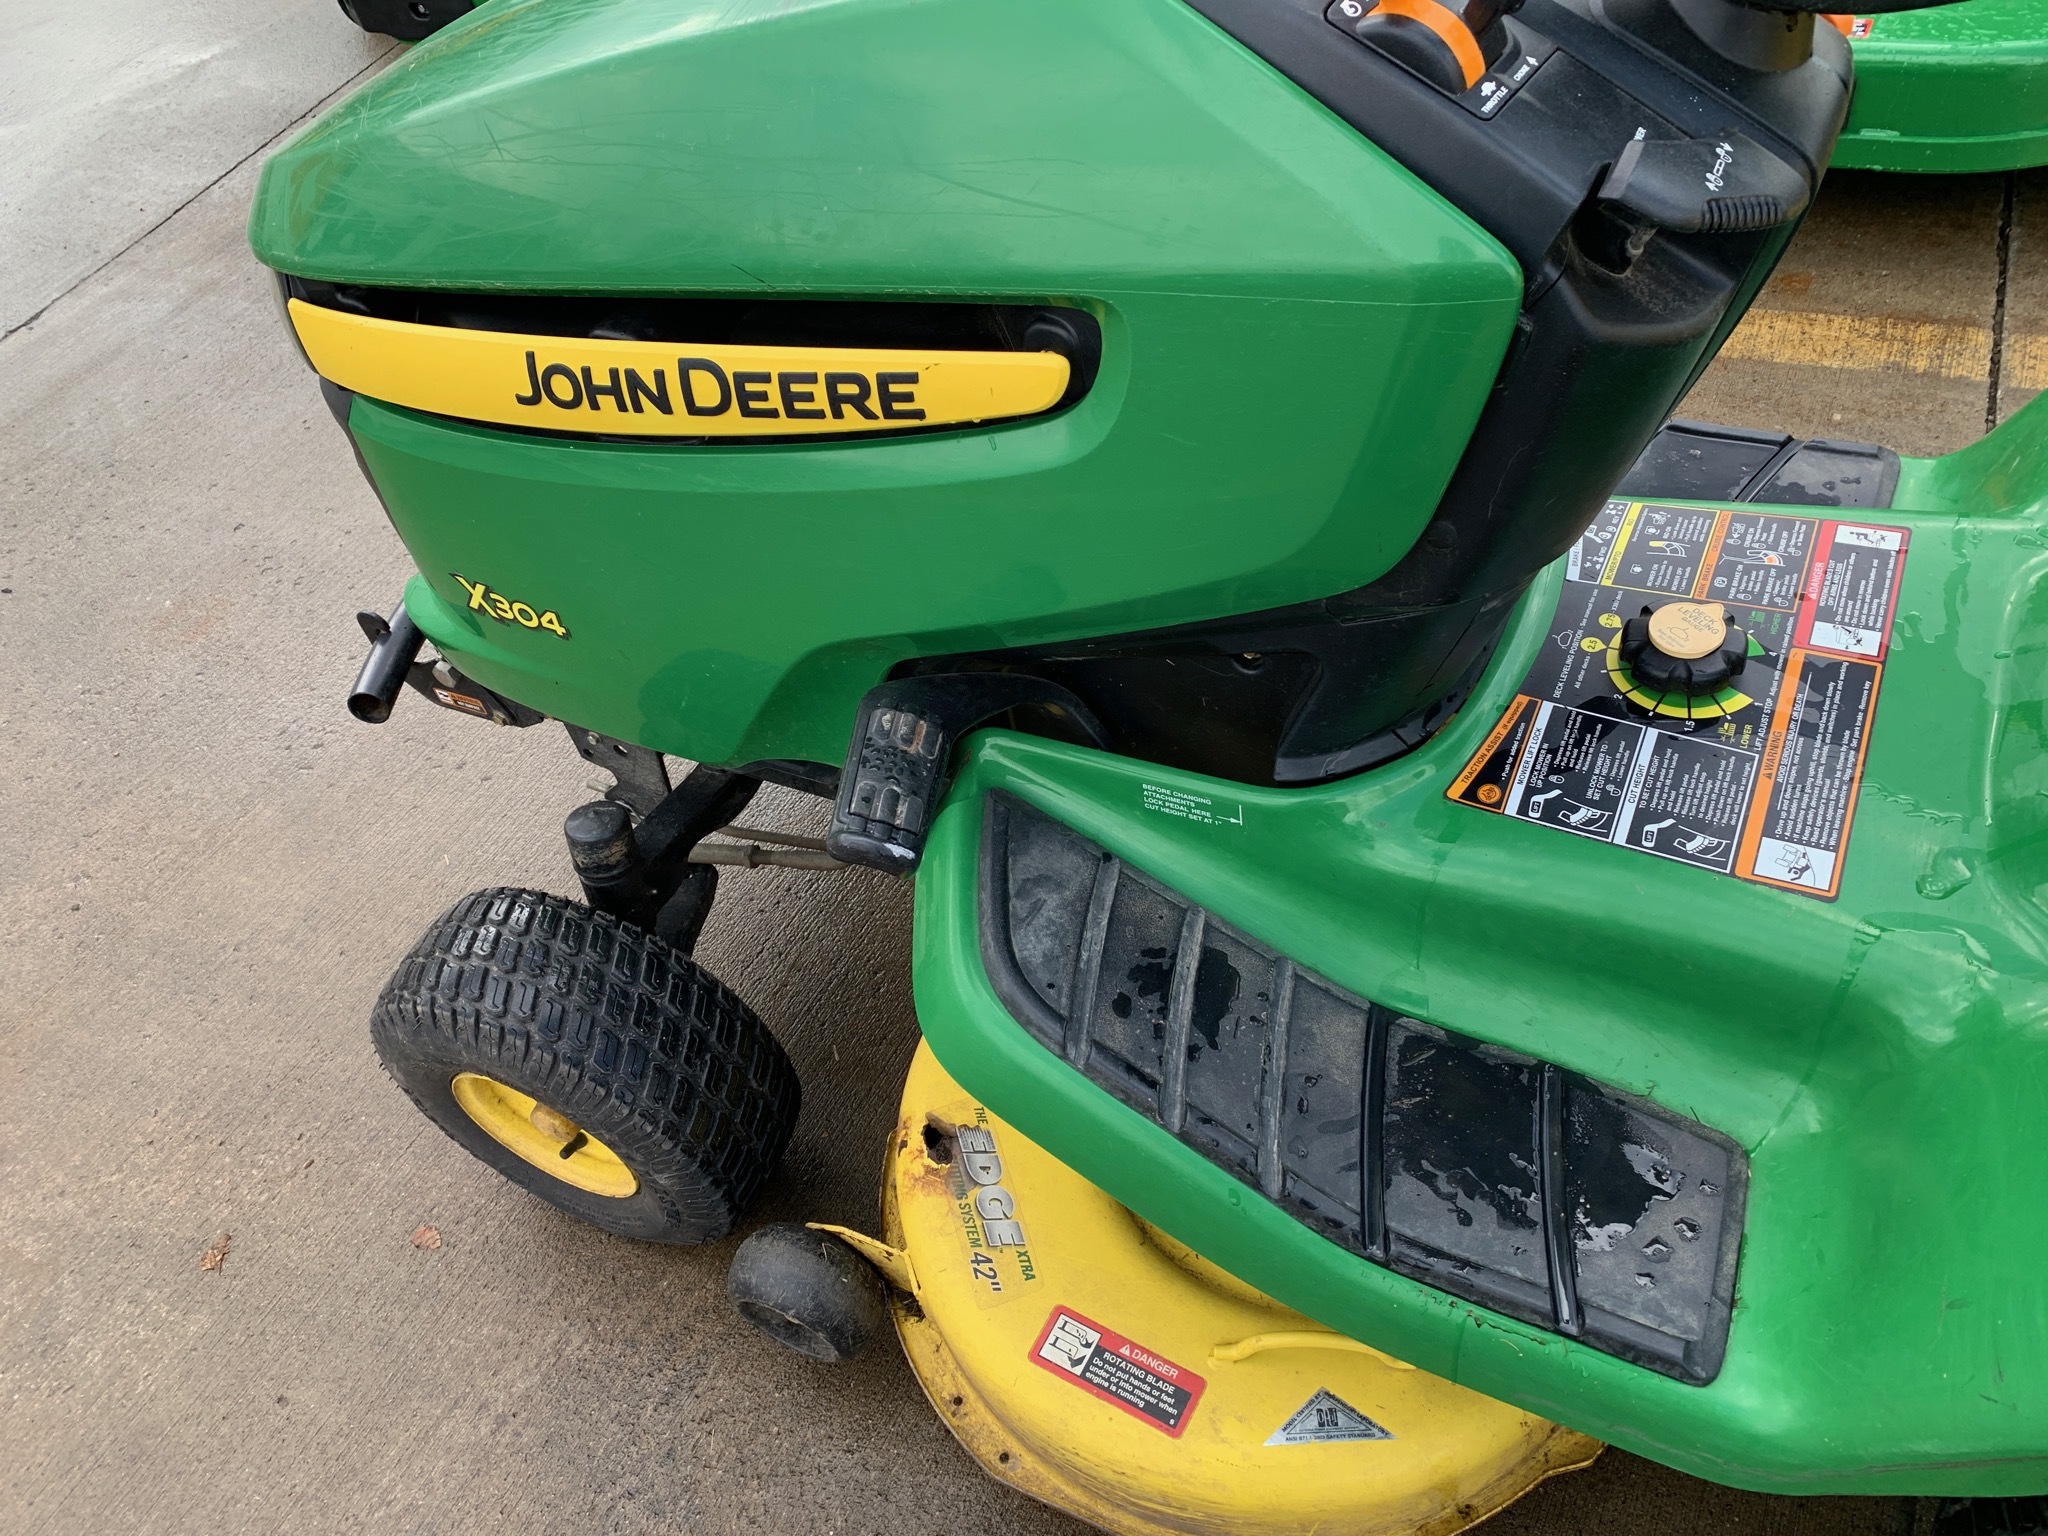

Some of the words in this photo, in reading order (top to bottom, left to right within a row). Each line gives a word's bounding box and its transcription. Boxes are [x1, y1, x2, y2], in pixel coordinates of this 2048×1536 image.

[1513, 64, 1531, 82] CHOKE
[1481, 85, 1509, 114] THROTTLE
[515, 350, 673, 415] JOHN
[677, 357, 926, 421] DEERE
[1711, 535, 1722, 552] CRUISE
[1717, 514, 1730, 534] CONTROL
[1696, 584, 1706, 598] PARK
[1702, 563, 1713, 581] BRAKE
[1809, 562, 1825, 592] DANGER
[449, 574, 570, 638] X304
[1692, 607, 1717, 625] DECK
[1605, 614, 1616, 627] 2.75
[1678, 606, 1720, 635] LEVELING
[1681, 616, 1704, 632] GAUGE
[1770, 613, 1782, 635] HIGHER
[1553, 682, 1565, 698] DECK
[1559, 654, 1575, 681] LEVELING
[1569, 630, 1585, 654] POSITION
[1583, 603, 1593, 618] manual
[1588, 640, 1598, 650] 2.5
[1581, 656, 1591, 669] decks
[1577, 670, 1586, 681] other
[1764, 698, 1773, 713] STOP
[1794, 693, 1804, 711] DEATH
[1684, 720, 1695, 732] 1.5
[1757, 714, 1769, 737] ADJUST
[1792, 711, 1800, 720] OR
[1739, 724, 1753, 749] LOWER
[1787, 720, 1797, 740] INJURY
[1461, 753, 1488, 783] TRACTION
[1483, 731, 1504, 753] ASSIST
[1505, 701, 1525, 724] equipped)
[1501, 764, 1511, 777] Push
[1509, 741, 1519, 756] added
[1515, 722, 1526, 740] traction
[1754, 737, 1763, 750] LIFT
[1764, 730, 1782, 771] WARNING
[1781, 740, 1793, 765] SERIOUS
[1796, 738, 1804, 754] across
[1516, 759, 1531, 785] MOWER
[1526, 746, 1536, 759] LIFT
[1531, 727, 1542, 745] LOCK
[1539, 754, 1552, 779] POSITION
[1601, 755, 1612, 776] HEIGHT
[1617, 765, 1626, 778] Lower
[1622, 750, 1630, 764] handle
[1649, 755, 1661, 776] HEIGHT
[1529, 770, 1540, 786] LOCK
[1535, 749, 1547, 770] MOWER
[1586, 775, 1598, 799] UNLOCK
[1594, 752, 1606, 774] MOWER
[1632, 764, 1646, 789] HEIGHT
[1777, 766, 1787, 782] AVOID
[1788, 764, 1798, 783] slopes,
[1536, 779, 1544, 788] UP
[1597, 776, 1606, 788] CUT
[1645, 776, 1654, 788] CUT
[1784, 784, 1793, 799] down
[1793, 784, 1802, 798] turns
[1820, 821, 1831, 844] Remove
[1826, 799, 1836, 821] objects
[1836, 752, 1846, 770] thrown
[1842, 730, 1851, 744] blade
[1821, 778, 1831, 798] manual
[1142, 783, 1171, 795] BEFORE
[1173, 791, 1212, 805] CHANGING
[1143, 790, 1195, 807] ATTACHMENTS
[1593, 789, 1602, 800] SET
[1628, 789, 1638, 804] CUT
[1639, 800, 1647, 809] TO
[1642, 788, 1650, 800] SET
[1143, 797, 1163, 806] LOCK
[1165, 801, 1189, 812] PEDAL
[1191, 808, 1211, 817] HERE
[1144, 803, 1159, 811] CUT
[1160, 806, 1187, 818] HEIGHT
[1188, 813, 1202, 821] SET
[1532, 802, 1540, 813] LIFT
[1788, 798, 1799, 820] sudden
[1815, 798, 1827, 827] operator's
[1645, 831, 1654, 842] LIFT
[1775, 819, 1784, 835] Drive
[1784, 820, 1794, 836] Avoid
[1811, 827, 1820, 842] Read
[973, 1106, 988, 1125] THE
[955, 1125, 1026, 1247] EDGE
[958, 1202, 983, 1248] SYSTEM
[968, 1251, 1003, 1292] 42"
[1016, 1249, 1036, 1281] XTRA
[1103, 1351, 1145, 1378] ROTATING
[1145, 1374, 1176, 1395] BLADE
[1131, 1349, 1179, 1380] DANGER
[1086, 1371, 1109, 1389] engine
[1110, 1383, 1117, 1392] is
[1117, 1388, 1144, 1408] running
[1090, 1364, 1110, 1381] under
[1110, 1376, 1119, 1384] or
[1119, 1378, 1132, 1392] into
[1133, 1388, 1158, 1406] mower
[1158, 1400, 1178, 1416] when
[1092, 1357, 1103, 1367] Do
[1102, 1361, 1115, 1373] not
[1116, 1368, 1129, 1381] put
[1129, 1373, 1151, 1393] hands
[1152, 1386, 1161, 1396] or
[1161, 1392, 1175, 1405] feet
